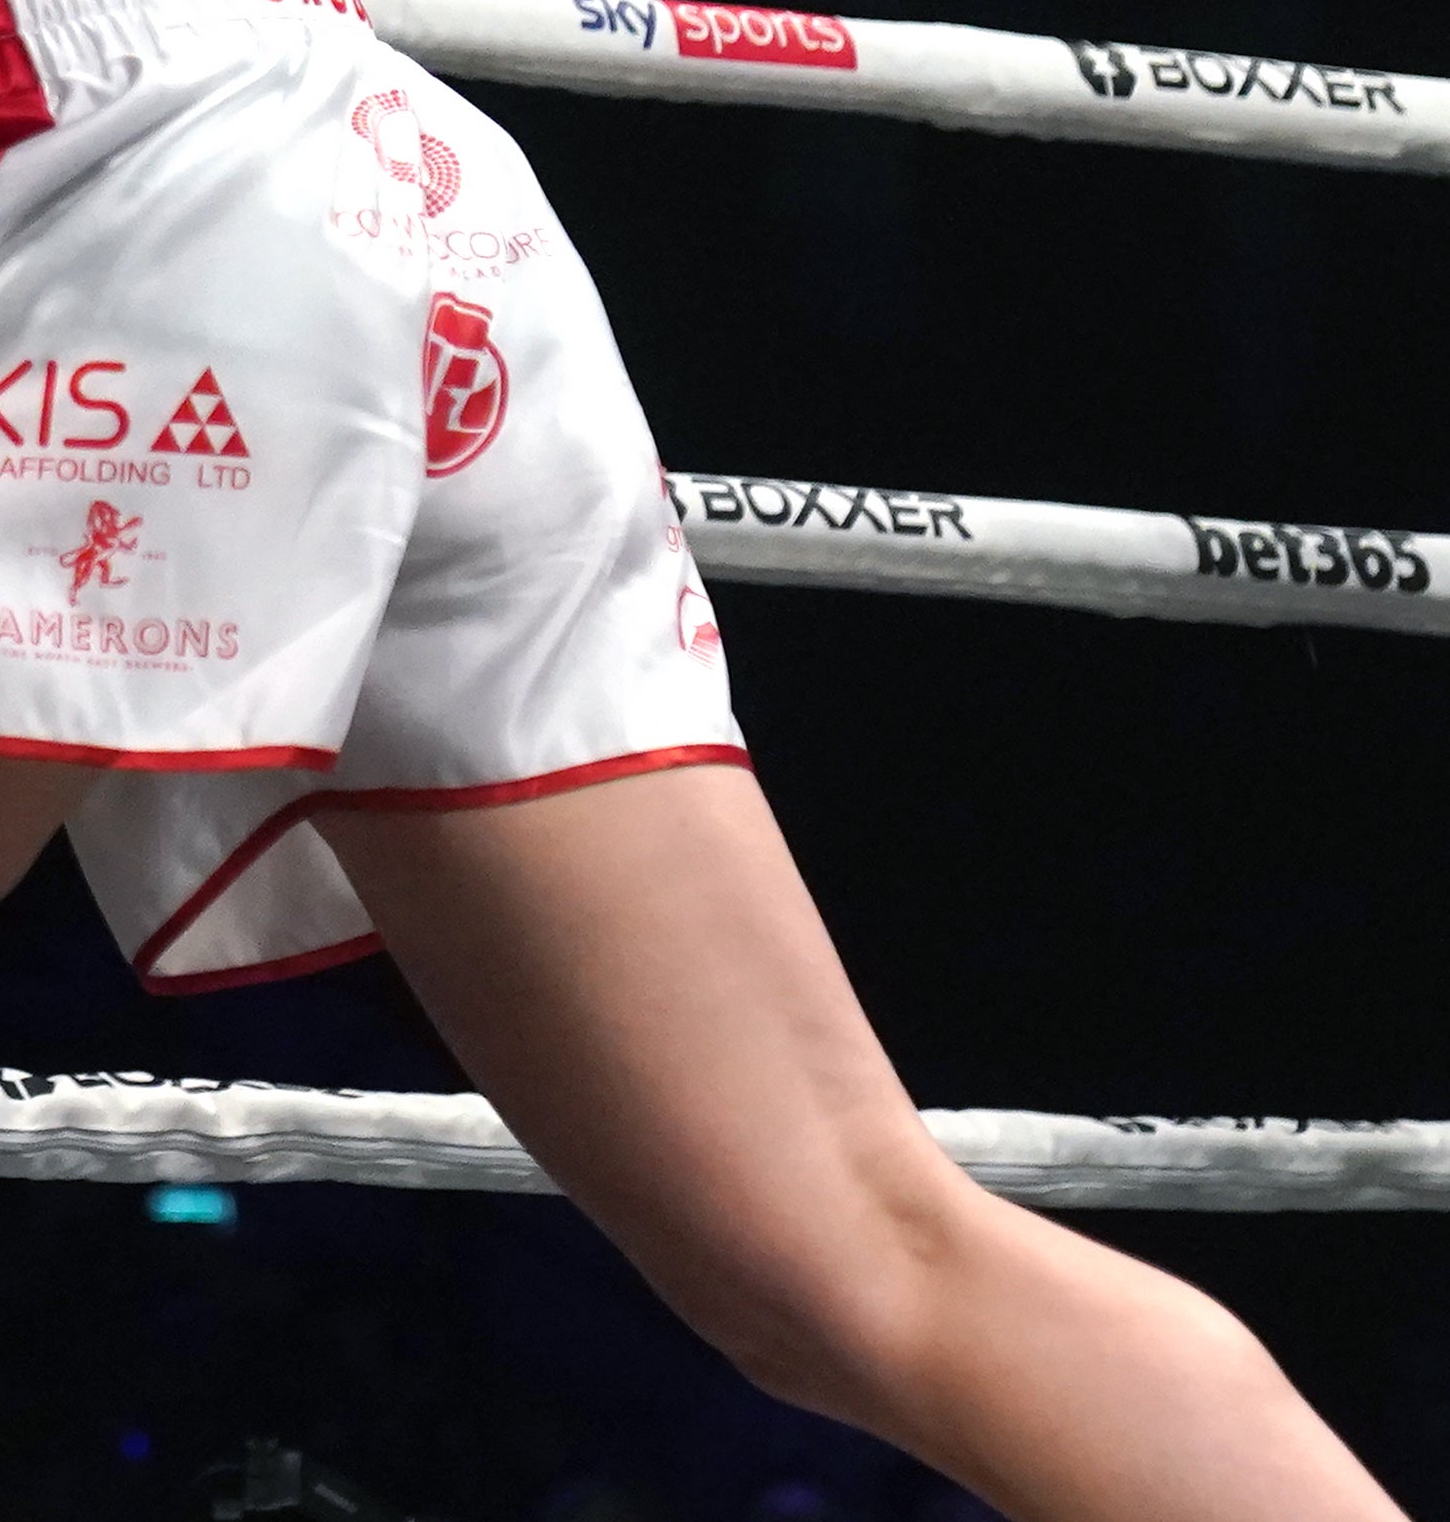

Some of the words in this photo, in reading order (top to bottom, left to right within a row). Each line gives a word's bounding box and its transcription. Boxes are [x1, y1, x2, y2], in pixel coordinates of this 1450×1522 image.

[680, 0, 846, 55] sports
[1147, 44, 1410, 118] BOXXER
[197, 463, 253, 492] LTD
[692, 476, 974, 543] BOXXER
[1190, 514, 1434, 596] bet365
